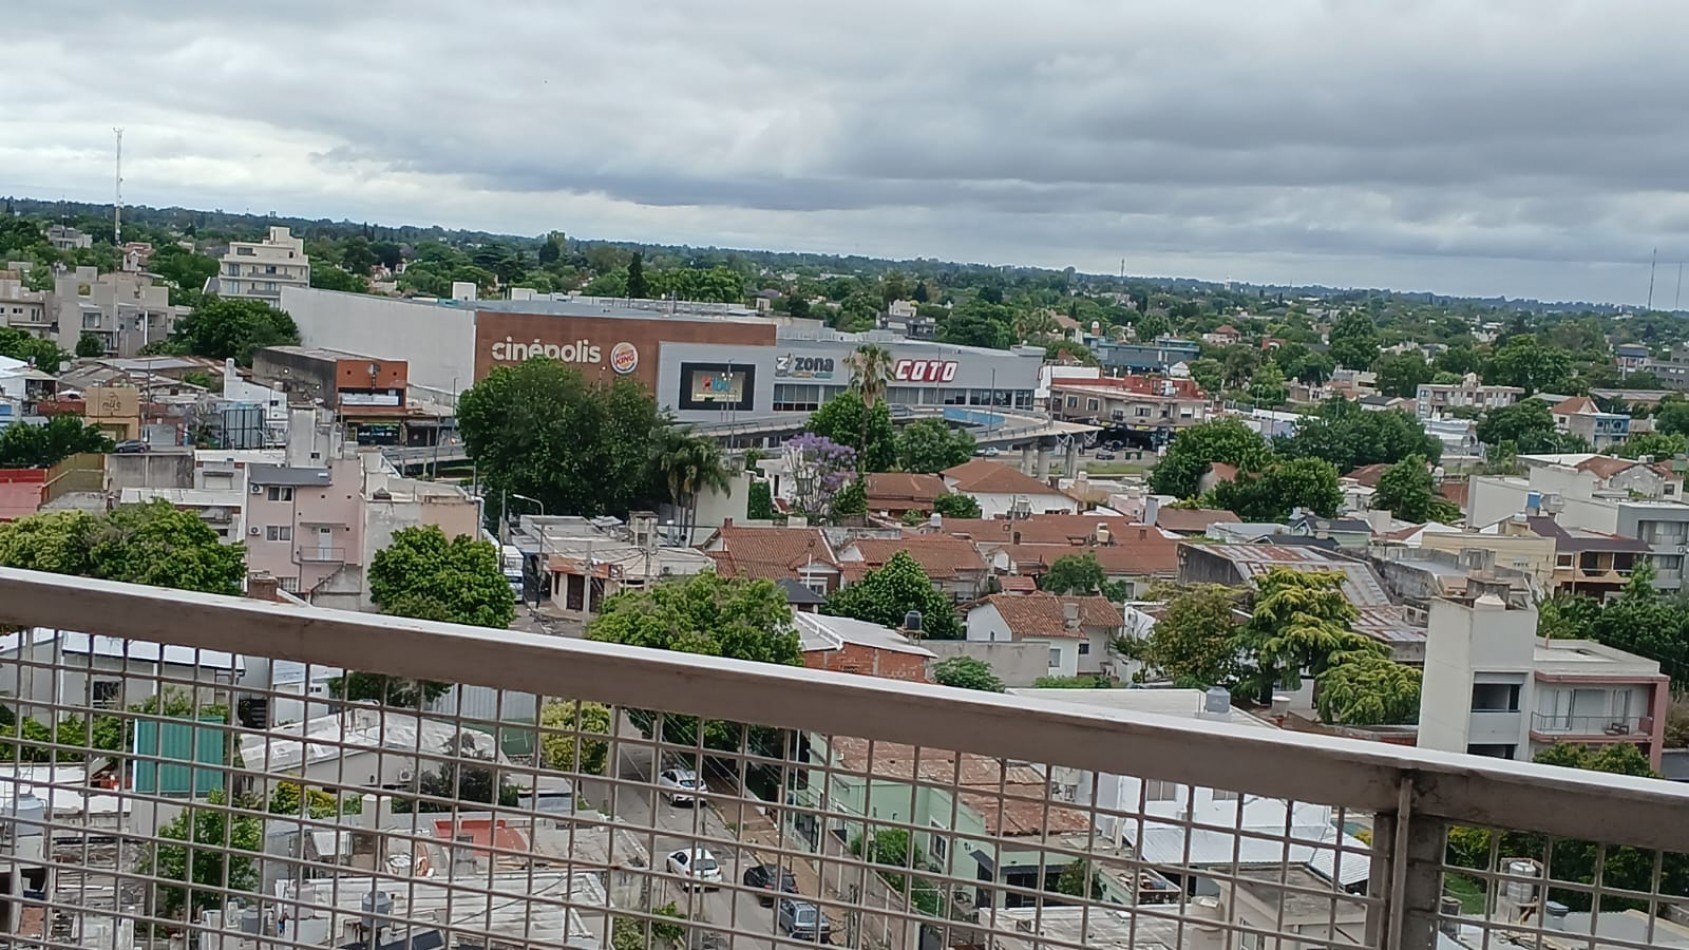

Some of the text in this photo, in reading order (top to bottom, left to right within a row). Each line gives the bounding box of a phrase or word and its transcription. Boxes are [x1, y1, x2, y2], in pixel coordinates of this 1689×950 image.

[491, 336, 602, 363] cinépolis
[794, 357, 835, 372] zona
[895, 360, 959, 382] COTO
